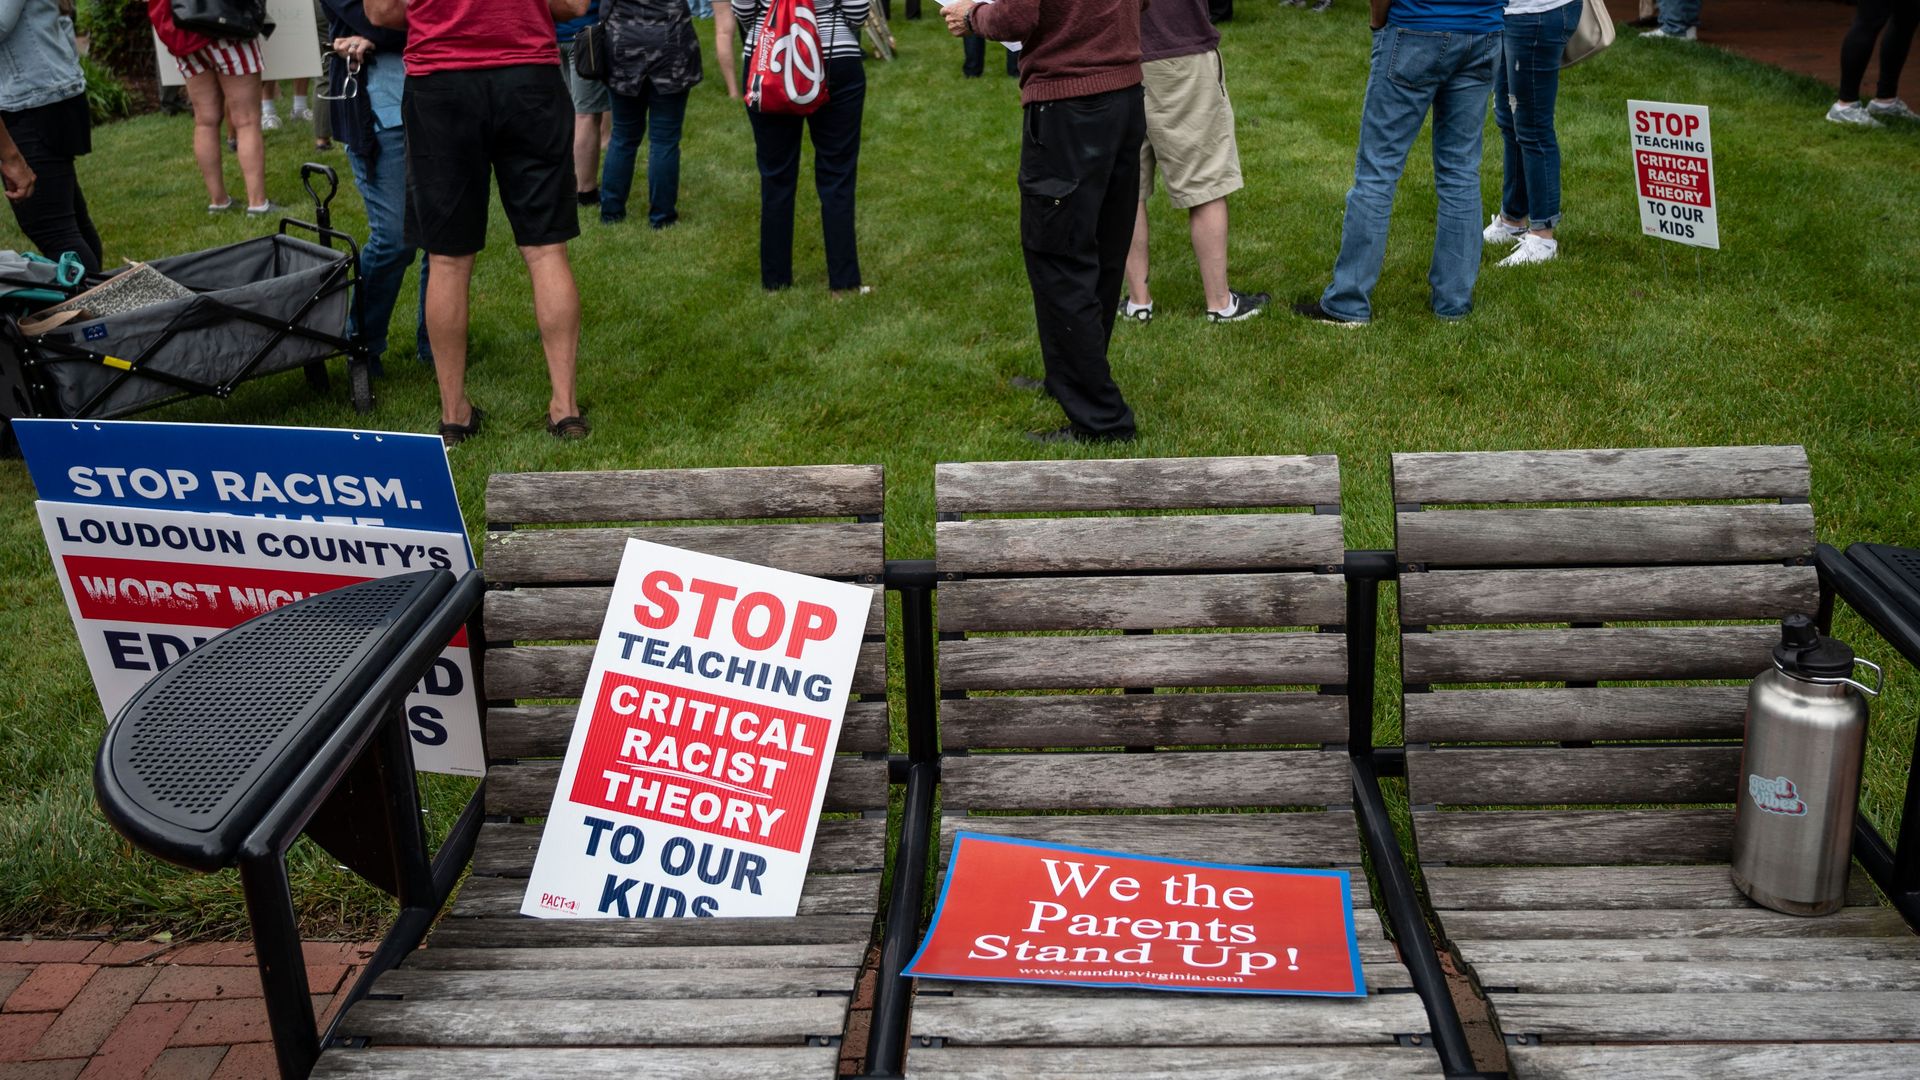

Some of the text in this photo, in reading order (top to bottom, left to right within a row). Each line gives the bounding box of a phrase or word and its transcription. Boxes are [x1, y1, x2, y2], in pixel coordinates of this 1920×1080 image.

[1635, 110, 1700, 138] STOP
[1635, 134, 1705, 153] TEACHING
[1639, 153, 1706, 173] CRITICAL
[1647, 168, 1699, 187] RACIST
[1646, 184, 1703, 204] THEORY
[1647, 200, 1705, 223] TO OUR
[1659, 219, 1695, 239] KIDS
[67, 466, 423, 510] STOP RACISM.
[56, 517, 246, 555] LOUDOUN
[256, 532, 453, 570] COUNTY’S
[79, 575, 221, 611] WORST
[633, 570, 838, 660] STOP
[103, 630, 207, 672] ED
[618, 631, 833, 702] TEACHING
[609, 684, 815, 756] CRITICAL
[620, 727, 787, 790] RACIST
[602, 770, 786, 838] THEORY
[583, 815, 768, 896] TO OUR
[541, 892, 567, 909] PACT
[1040, 858, 1254, 911] We the
[1021, 900, 1257, 944] Parents
[967, 933, 1300, 976] Stand Up!
[1019, 966, 1244, 984] www.standupvirginia.com
